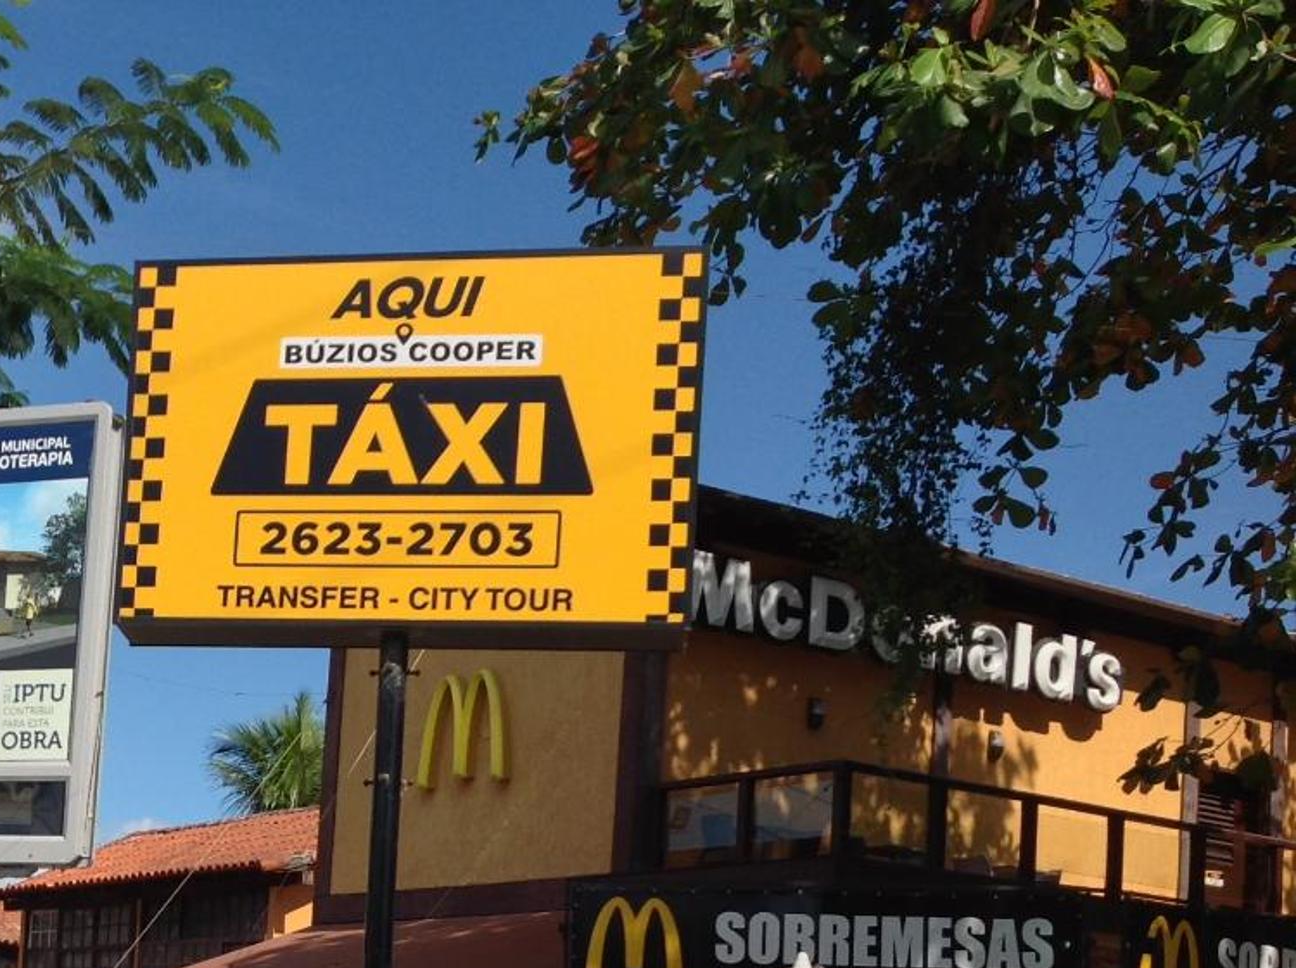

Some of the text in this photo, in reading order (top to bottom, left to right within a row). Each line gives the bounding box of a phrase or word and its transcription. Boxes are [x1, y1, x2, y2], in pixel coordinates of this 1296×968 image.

[331, 276, 486, 321] AQUI
[284, 338, 536, 365] BÚZIOS COOPER
[1, 436, 72, 453] MUNICIPAL
[265, 382, 547, 486] TÁXI
[259, 521, 534, 559] 2623-2703
[217, 584, 380, 610] TRANSFER
[408, 587, 477, 612] CITY
[488, 588, 573, 612] TOUR
[14, 683, 67, 703] IPTU
[1, 730, 62, 750] OBRA
